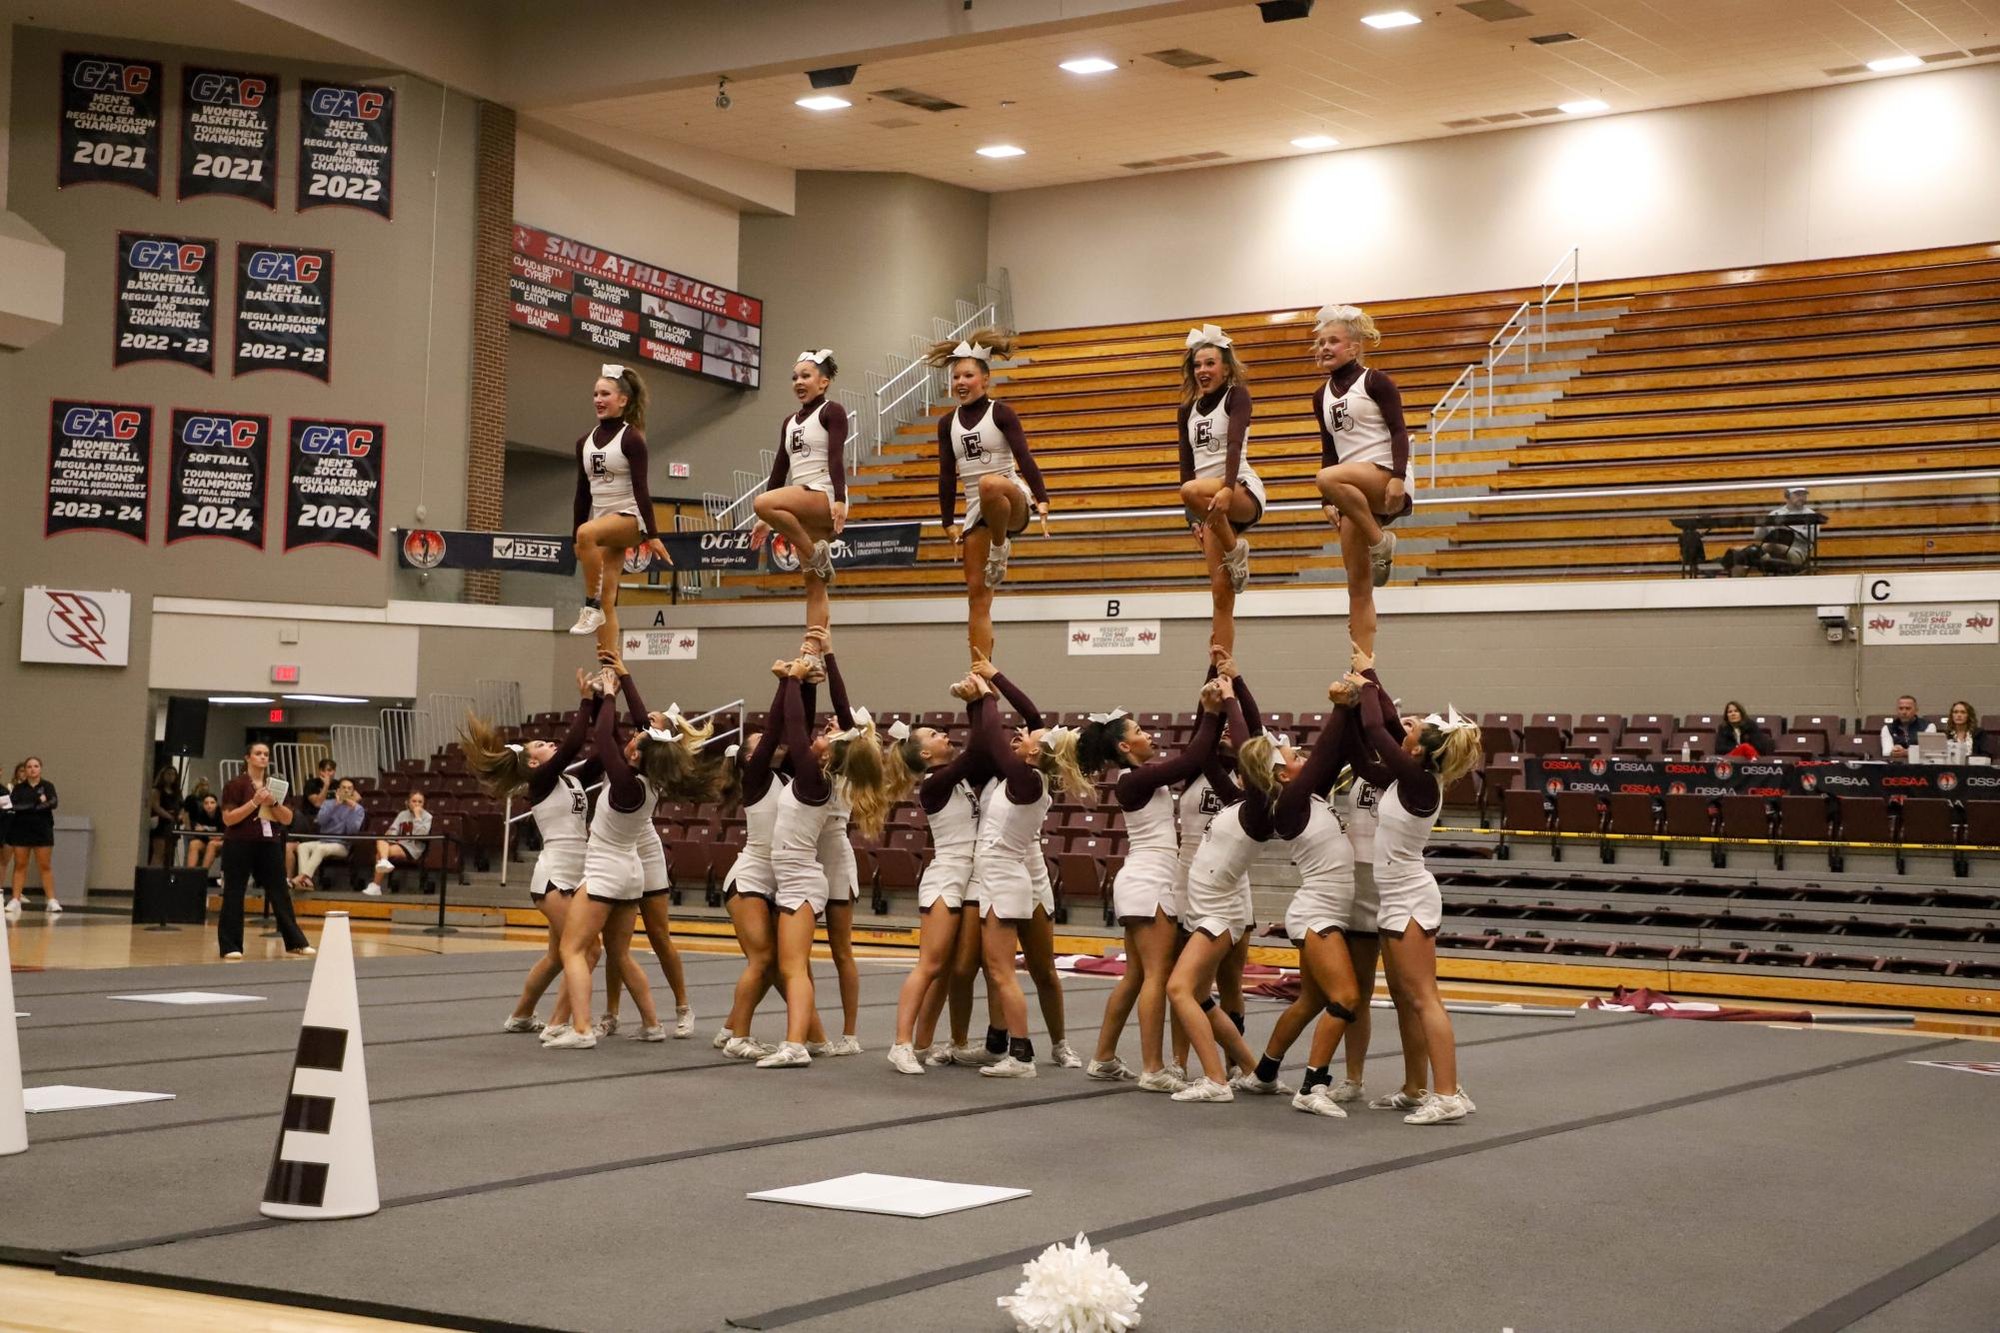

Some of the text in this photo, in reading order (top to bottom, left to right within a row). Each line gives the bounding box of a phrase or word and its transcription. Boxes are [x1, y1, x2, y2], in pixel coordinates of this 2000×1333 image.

[73, 60, 151, 94] GAC
[191, 74, 267, 107] GAC
[93, 93, 130, 105] MEN'S
[311, 88, 384, 120] GAC
[88, 102, 135, 115] SOCCER
[202, 105, 258, 120] WOMEN'S
[66, 110, 156, 128] REGULAR SEASON
[74, 119, 147, 135] CHAMPIONS
[191, 113, 268, 130] BASKETBALL
[329, 119, 365, 132] MEN'S
[194, 125, 265, 139] TOURNAMENT
[324, 128, 368, 141] SOCCER
[193, 133, 264, 148] CHAMPIONS
[303, 138, 388, 154] REGULAR SEASON
[73, 141, 146, 169] 2021
[312, 153, 380, 167] TOURNAMENT
[335, 149, 357, 157] AND
[192, 154, 263, 181] 2021
[311, 160, 379, 176] CHAMPIONS
[309, 174, 382, 201] 2022
[129, 240, 206, 273] GAC
[248, 251, 322, 283] GAC
[513, 256, 565, 278] CLAUD BETTY
[546, 236, 728, 307] SNU ATHLETICS
[139, 271, 197, 286] WOMEN'S
[127, 280, 206, 295] BASKETBALL
[266, 283, 303, 295] MEN'S
[510, 279, 568, 303] OUG MARGARET
[583, 277, 631, 299] CARL MARCIA
[121, 292, 210, 307] REGULAR SEASON
[245, 291, 322, 306] BASKETBALL
[524, 291, 549, 306] EATON
[592, 288, 622, 304] SAWYER
[130, 308, 202, 320] TOURNAMENT
[154, 303, 178, 311] AND
[515, 304, 560, 323] GARY LINDA
[129, 315, 201, 330] CHAMPIONS
[240, 311, 327, 326] REGULAR SEASON
[589, 311, 623, 328] WILLIAMS
[248, 321, 318, 335] CHAMPIONS
[581, 322, 632, 343] BOBBY DEBBIE
[649, 319, 692, 339] TERRY CAROL
[120, 333, 169, 351] 2022
[185, 337, 209, 353] 23
[591, 334, 620, 348] BOLTON
[655, 329, 686, 346] MURROW
[239, 342, 287, 360] 2022
[302, 346, 326, 363] 23
[63, 407, 141, 440] GAC
[1329, 399, 1348, 432] E
[182, 416, 259, 449] GAC
[792, 426, 805, 454] E
[1194, 419, 1213, 448] E
[72, 439, 131, 453] WOMEN'S
[300, 425, 373, 457] GAC
[961, 432, 983, 461] E
[59, 448, 140, 463] BASKETBALL
[187, 453, 250, 467] SOFTBALL
[318, 457, 355, 469] MEN'S
[54, 460, 145, 475] REGULAR SEASON
[313, 466, 358, 478] SOCCER
[590, 452, 607, 477] E
[62, 469, 136, 483] CHAMPIONS
[183, 469, 254, 481] TOURNAMENT
[292, 475, 378, 489] REGULAR SEASON
[51, 478, 147, 492] CENTRAL REGION HOST
[182, 477, 254, 491] CHAMPIONS
[300, 483, 369, 497] CHAMPIONS
[50, 486, 80, 496] SWEET
[90, 489, 148, 500] APPEARANCE
[182, 487, 251, 499] CENTRAL REGION
[198, 495, 237, 505] FINALIST
[52, 501, 102, 519] 2023
[117, 505, 142, 520] 24
[178, 504, 254, 531] 2024
[298, 504, 371, 530] 2024
[514, 543, 561, 558] BEEF
[1871, 579, 1891, 601] C
[1107, 599, 1121, 617] B
[1908, 610, 1951, 618] RESERVED
[653, 610, 665, 626] A
[1930, 623, 1963, 631] CHASER
[1542, 761, 1582, 770] OSSAA
[1613, 762, 1655, 773] OSSAA
[1664, 763, 1708, 774] OSSAA
[1741, 765, 1784, 775] OSSAA
[1825, 776, 1870, 787] OSSAA
[1882, 776, 1929, 787] OSSAA
[1357, 782, 1376, 809] E
[1569, 782, 1738, 796] OSSAA OSSAA OSSAA
[570, 791, 587, 814] E
[1199, 786, 1219, 815] E
